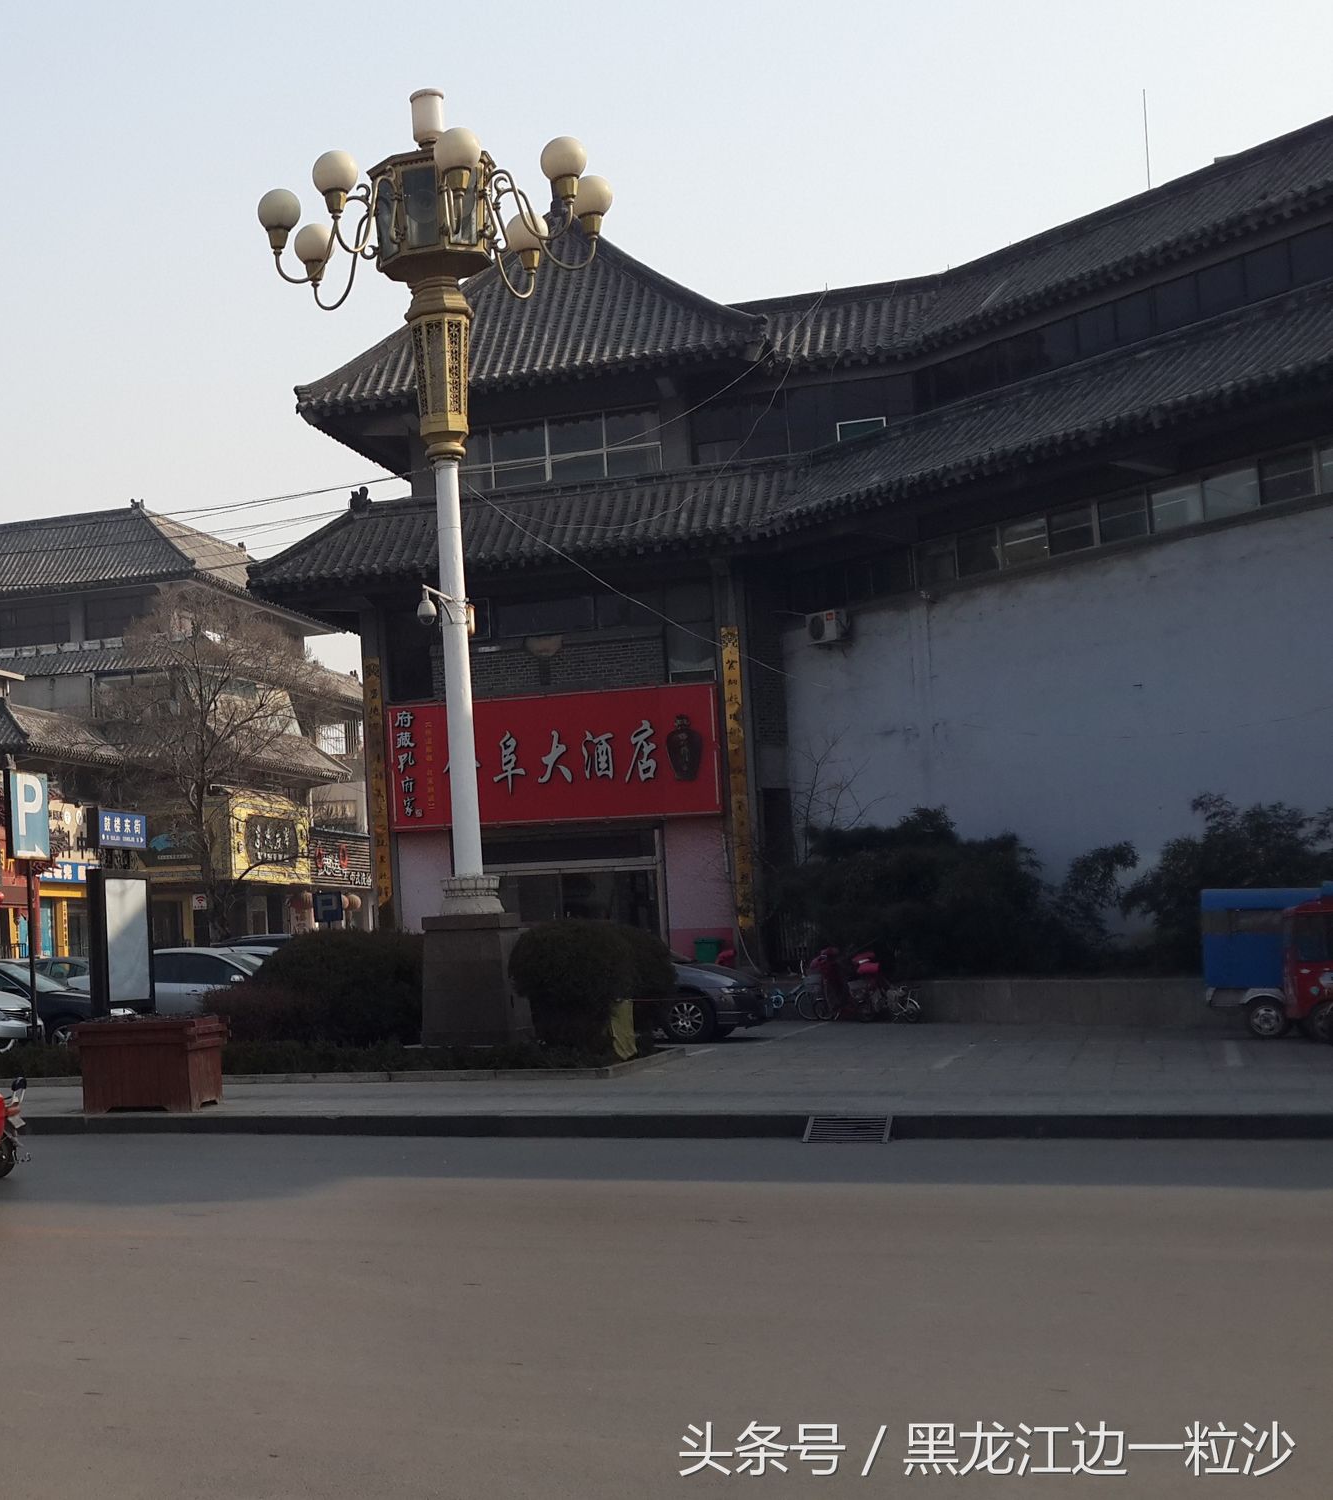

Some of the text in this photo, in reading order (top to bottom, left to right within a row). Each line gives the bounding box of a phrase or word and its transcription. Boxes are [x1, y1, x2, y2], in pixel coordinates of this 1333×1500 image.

[443, 720, 660, 795] 阜大酒店
[17, 773, 43, 836] P
[103, 815, 141, 835] 鼓楼东街
